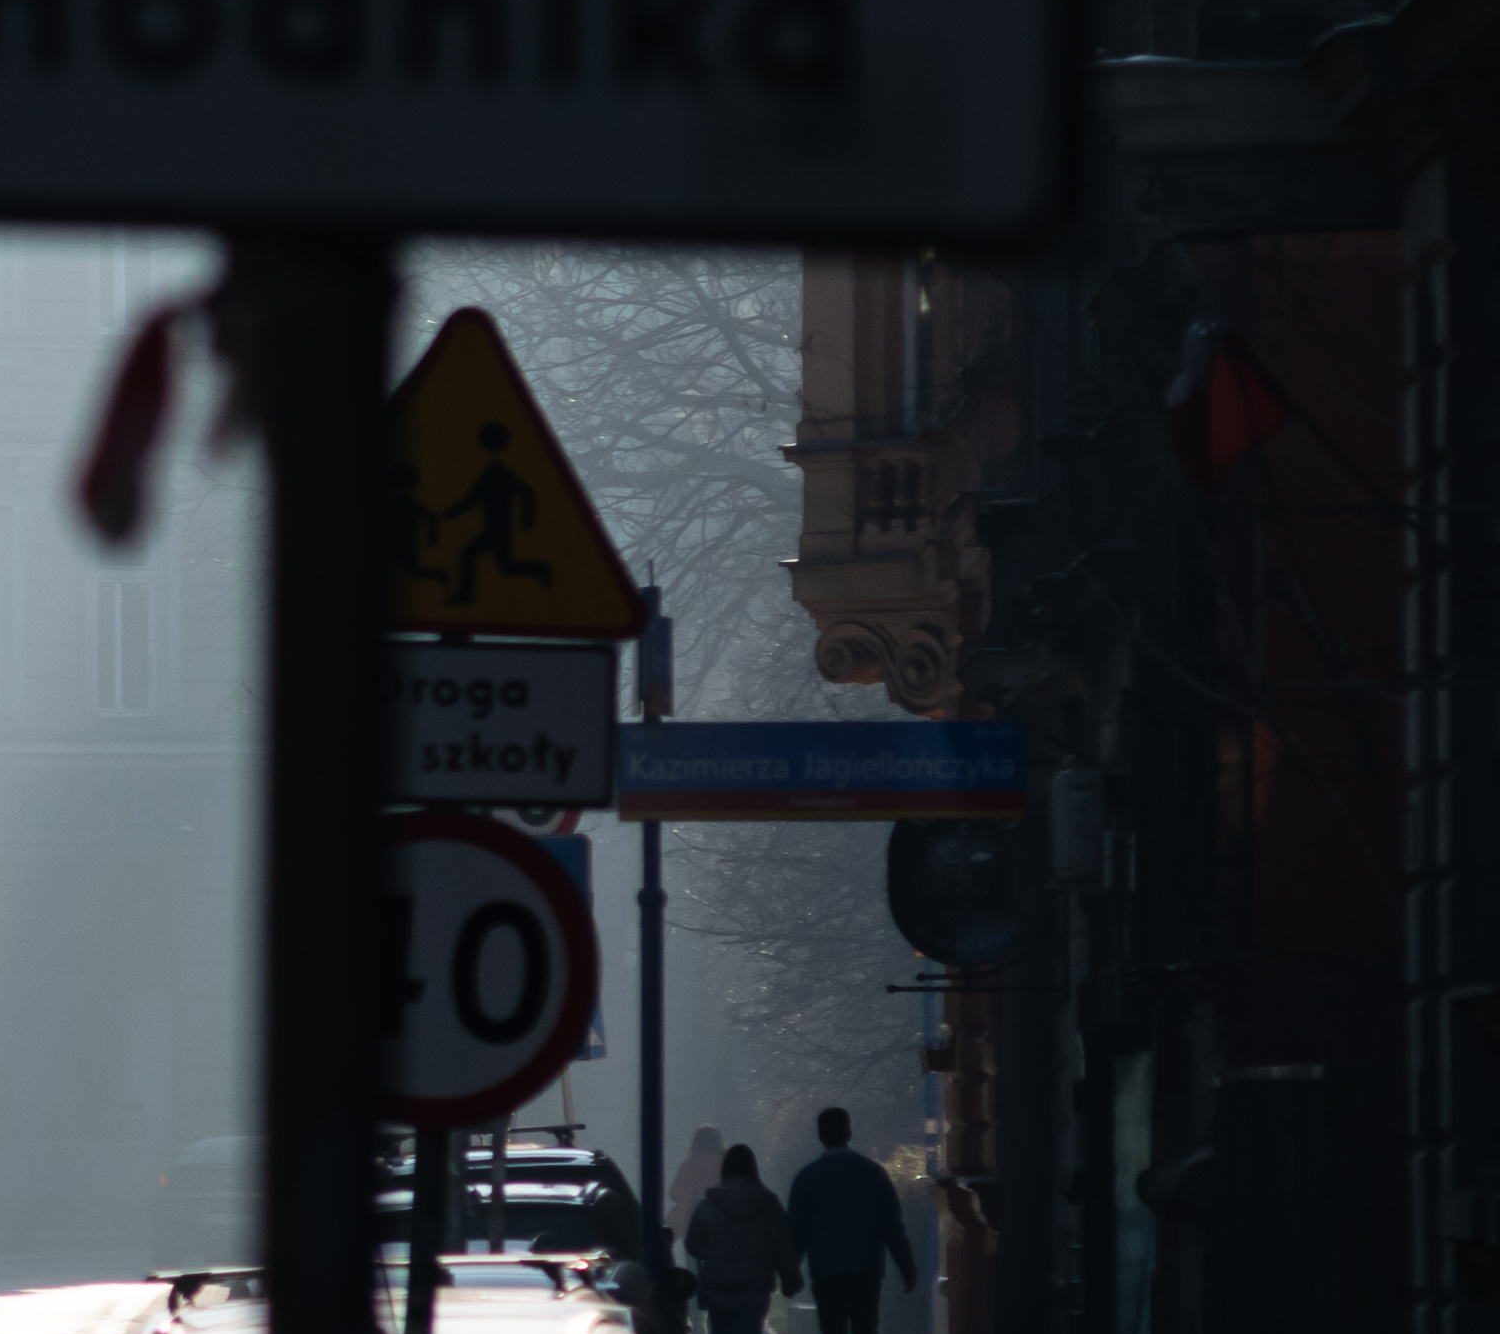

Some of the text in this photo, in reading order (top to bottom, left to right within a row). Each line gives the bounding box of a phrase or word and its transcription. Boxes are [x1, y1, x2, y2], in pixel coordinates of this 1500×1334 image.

[422, 732, 577, 786] szkoły
[629, 751, 1015, 787] Kazimierza Jagiellończyka
